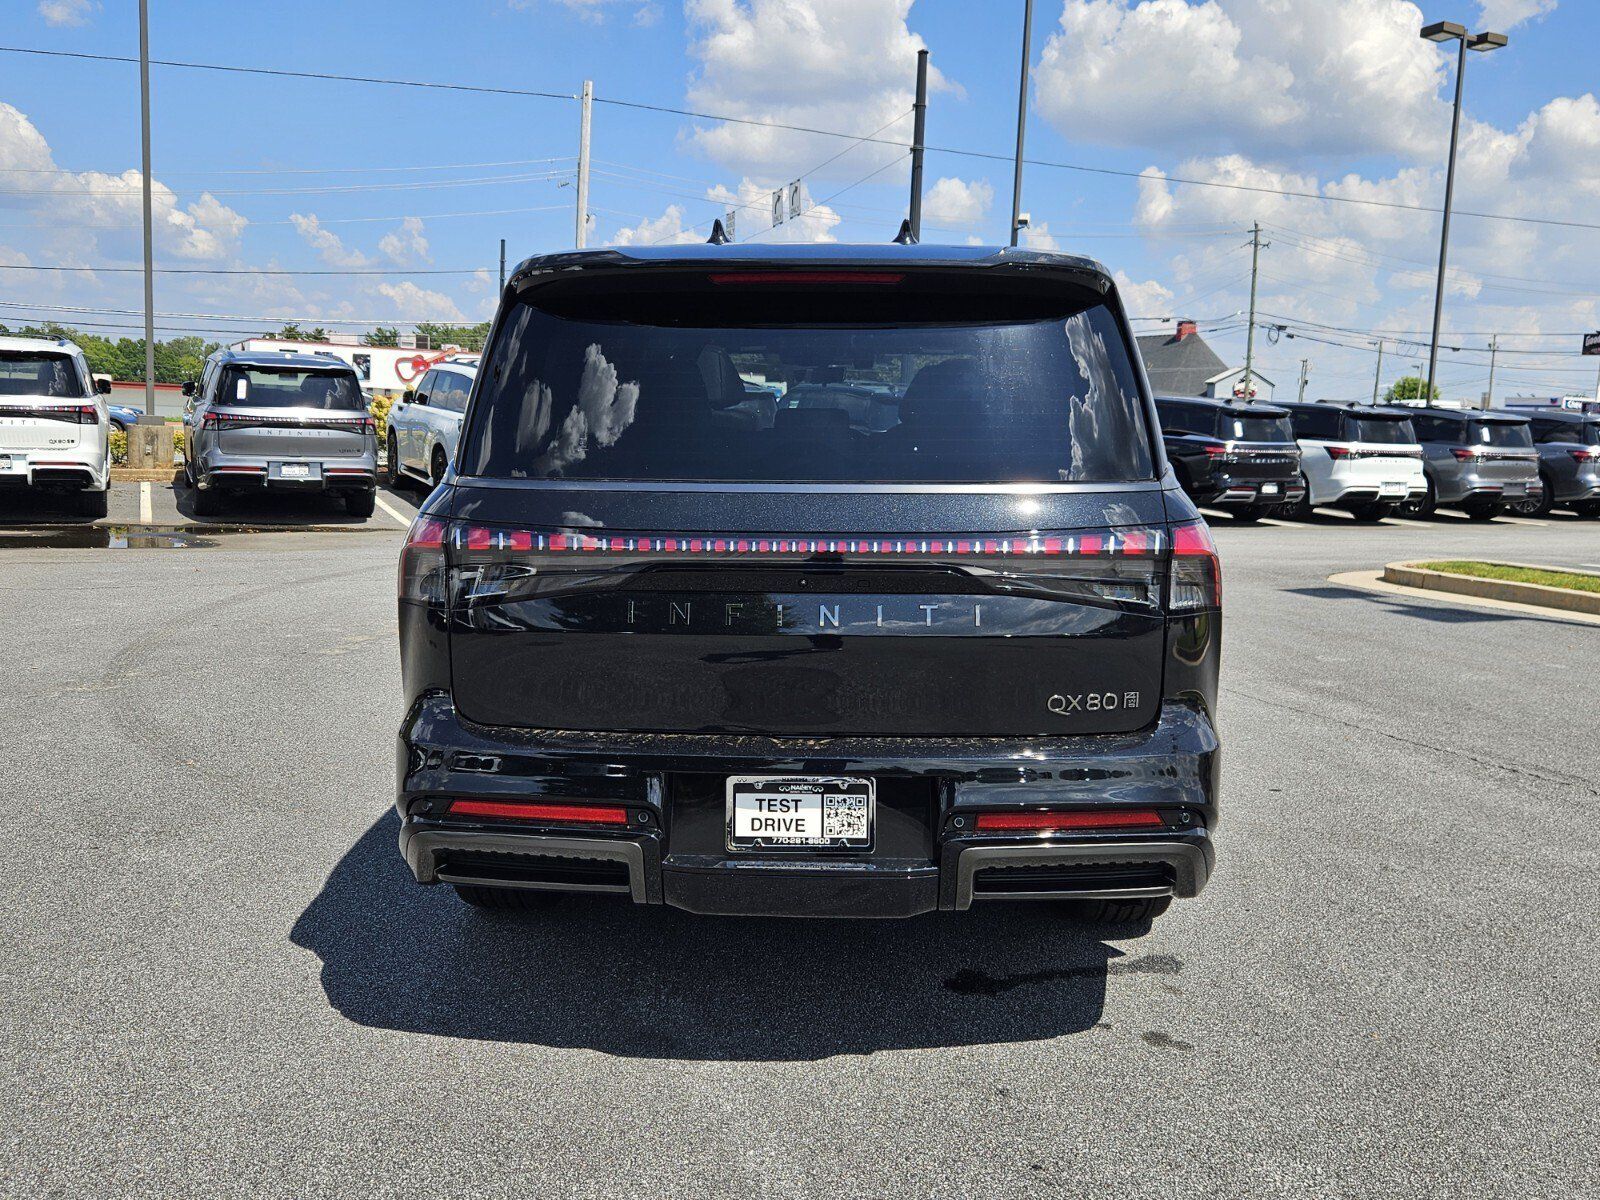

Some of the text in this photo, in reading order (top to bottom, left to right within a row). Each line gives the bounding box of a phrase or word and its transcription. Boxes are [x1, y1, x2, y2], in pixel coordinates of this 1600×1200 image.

[627, 601, 982, 628] INFINITI
[1047, 692, 1118, 716] QX80
[755, 799, 802, 812] TEST
[751, 818, 805, 832] DRIVE
